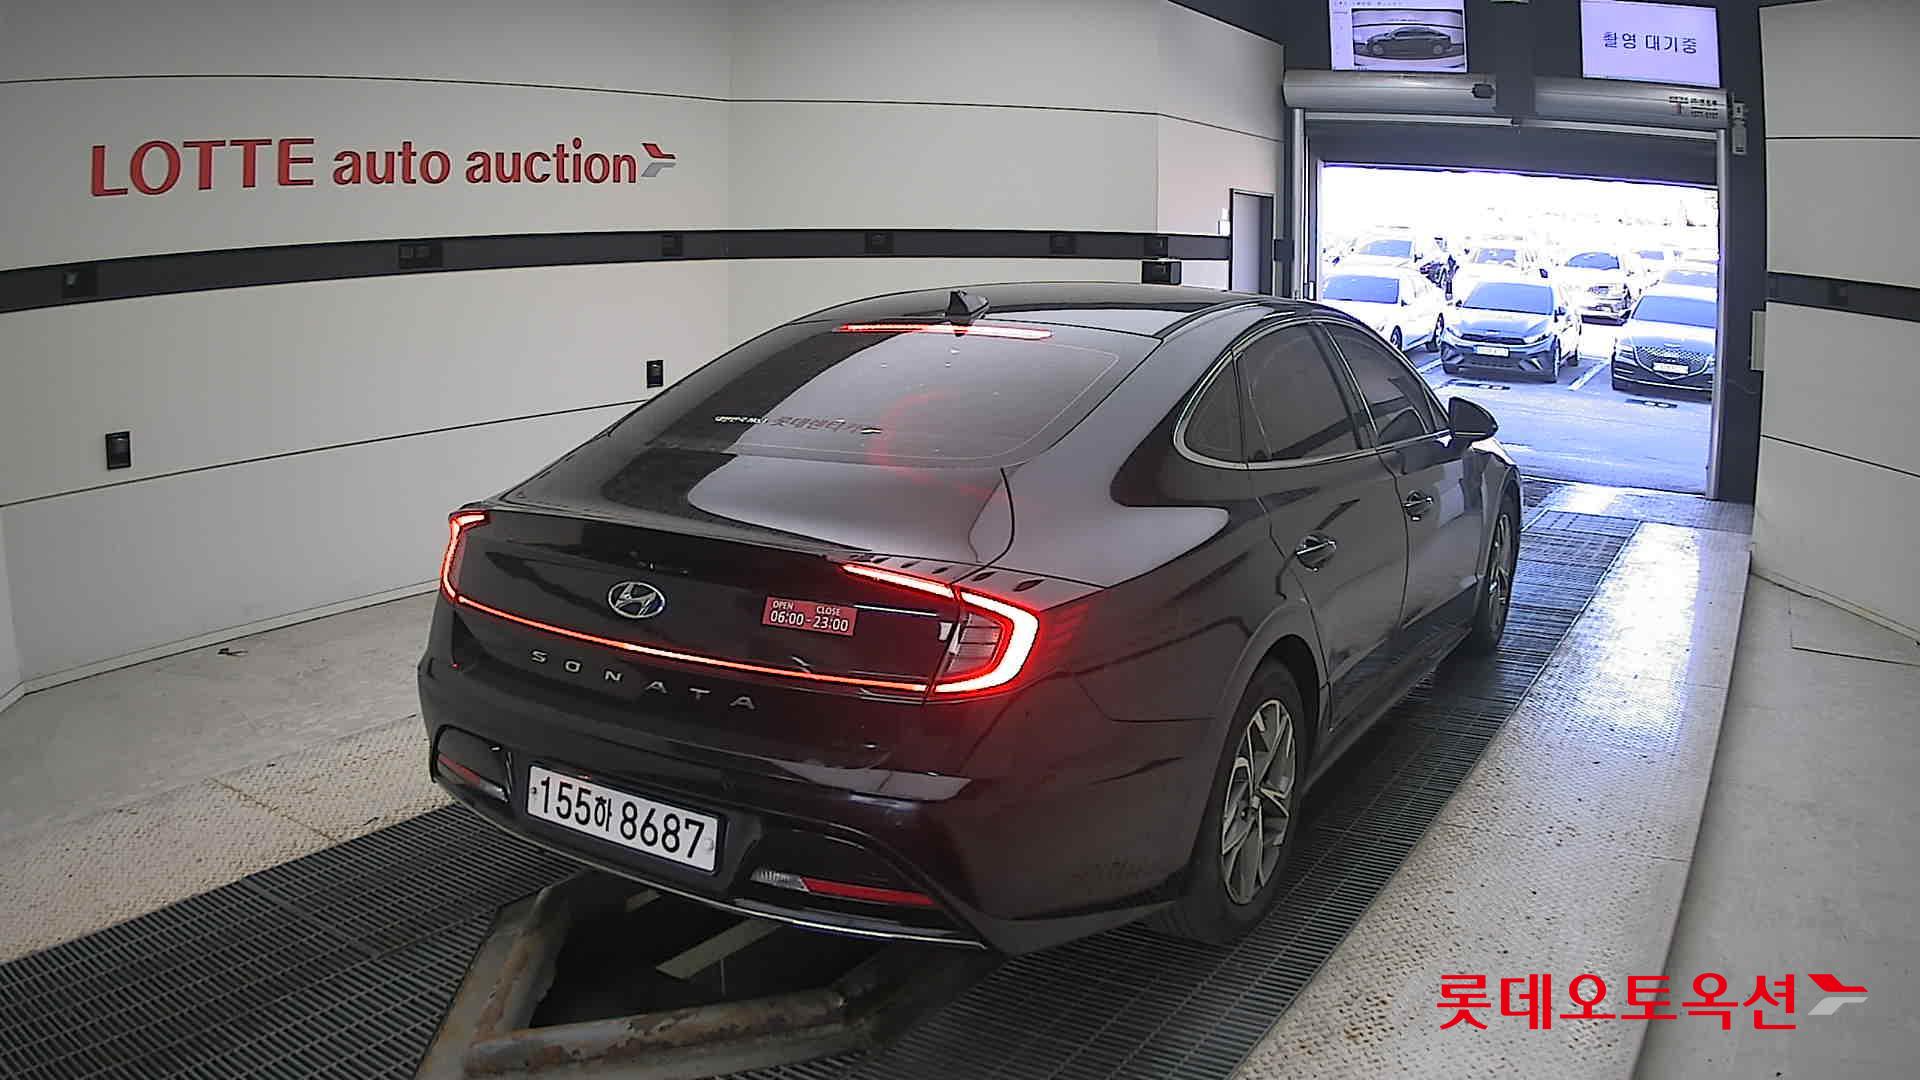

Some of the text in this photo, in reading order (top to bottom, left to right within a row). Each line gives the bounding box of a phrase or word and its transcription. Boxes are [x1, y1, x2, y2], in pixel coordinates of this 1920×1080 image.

[1645, 34, 1697, 54] 대기중
[91, 138, 638, 197] LOTTE auto auction
[773, 600, 841, 617] OPEN CLOSE
[770, 610, 804, 626] 06:00
[813, 615, 849, 632] 23:00
[530, 649, 756, 710] SONATA
